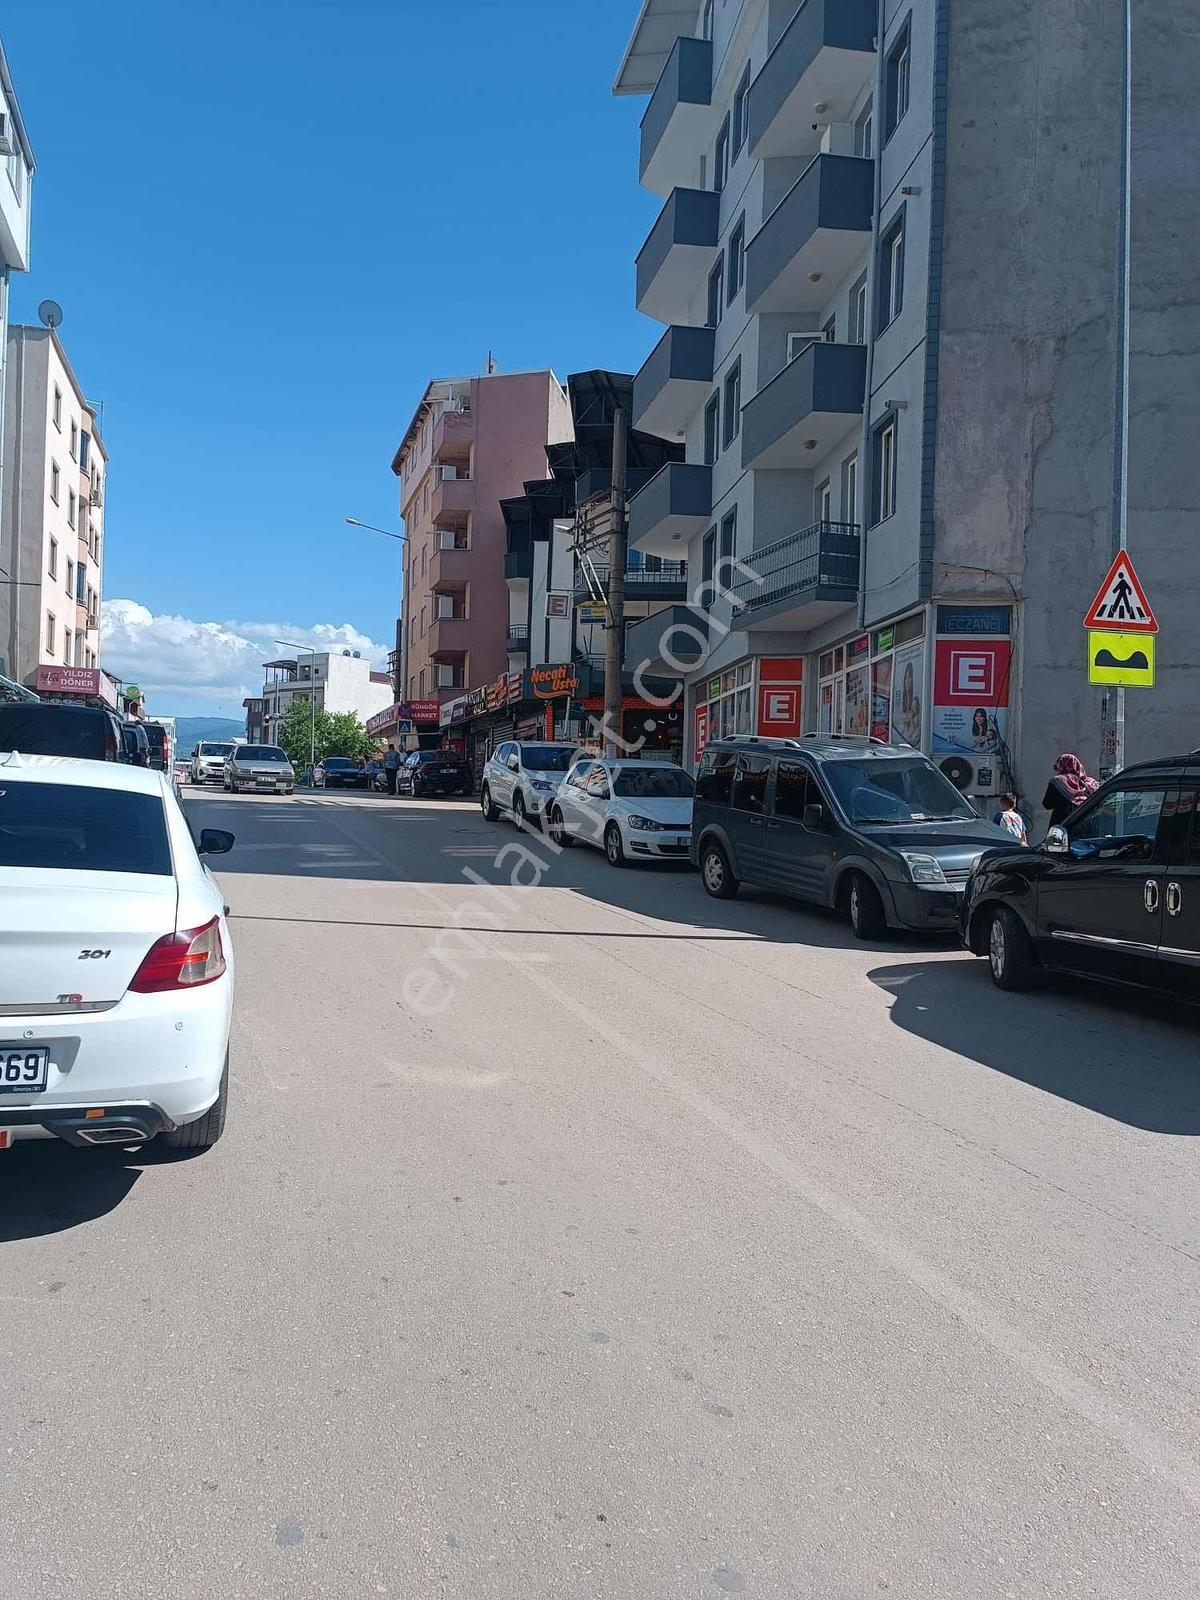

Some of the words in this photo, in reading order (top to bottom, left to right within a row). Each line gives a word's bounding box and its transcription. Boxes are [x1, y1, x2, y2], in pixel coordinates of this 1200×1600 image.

[551, 598, 565, 614] E
[949, 619, 997, 630] ECZANE
[63, 670, 93, 678] YILDIZ
[531, 667, 567, 682] Necati
[958, 658, 986, 689] E
[60, 678, 93, 687] DÖNER
[552, 678, 577, 690] Usta
[770, 695, 790, 719] E
[698, 719, 706, 749] E
[78, 950, 111, 959] 301
